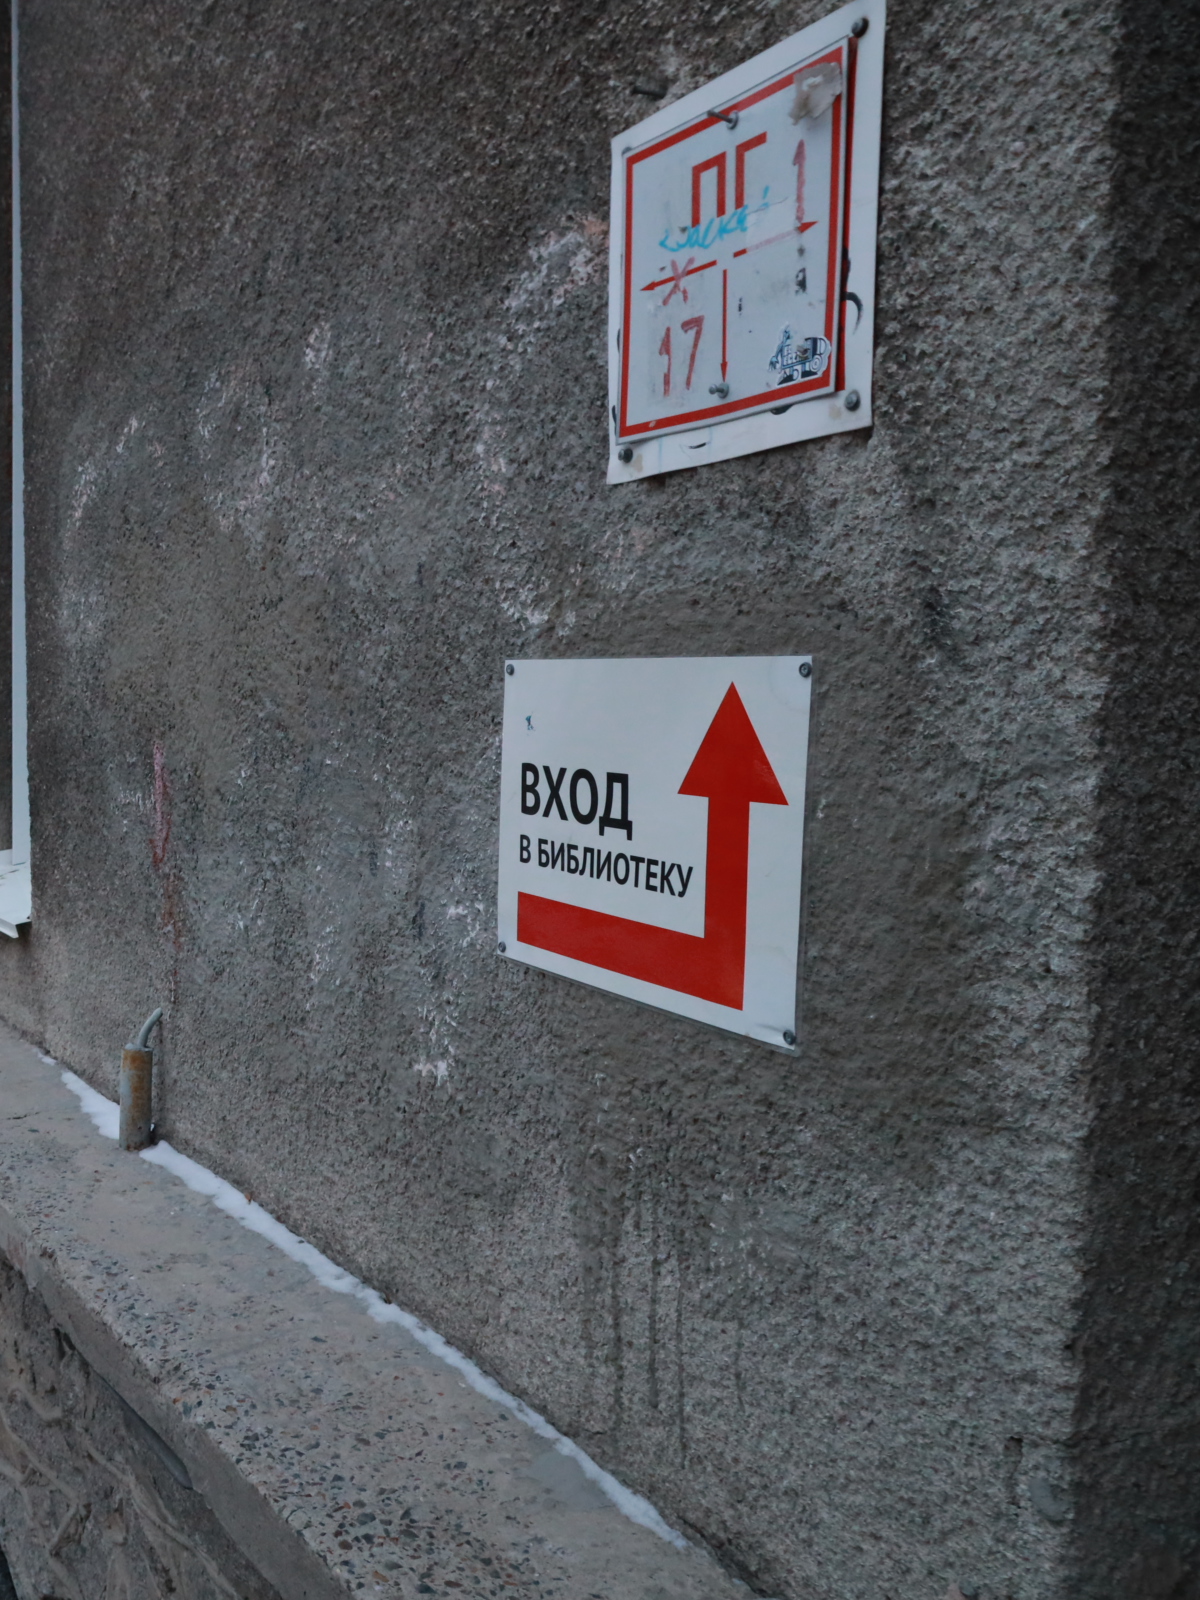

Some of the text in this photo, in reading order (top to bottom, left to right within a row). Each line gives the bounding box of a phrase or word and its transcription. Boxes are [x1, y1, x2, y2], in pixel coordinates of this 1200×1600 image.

[691, 131, 768, 228] ПГ
[520, 761, 634, 842] ВХОД
[518, 833, 694, 899] В БИБЛИОТЕКУ
